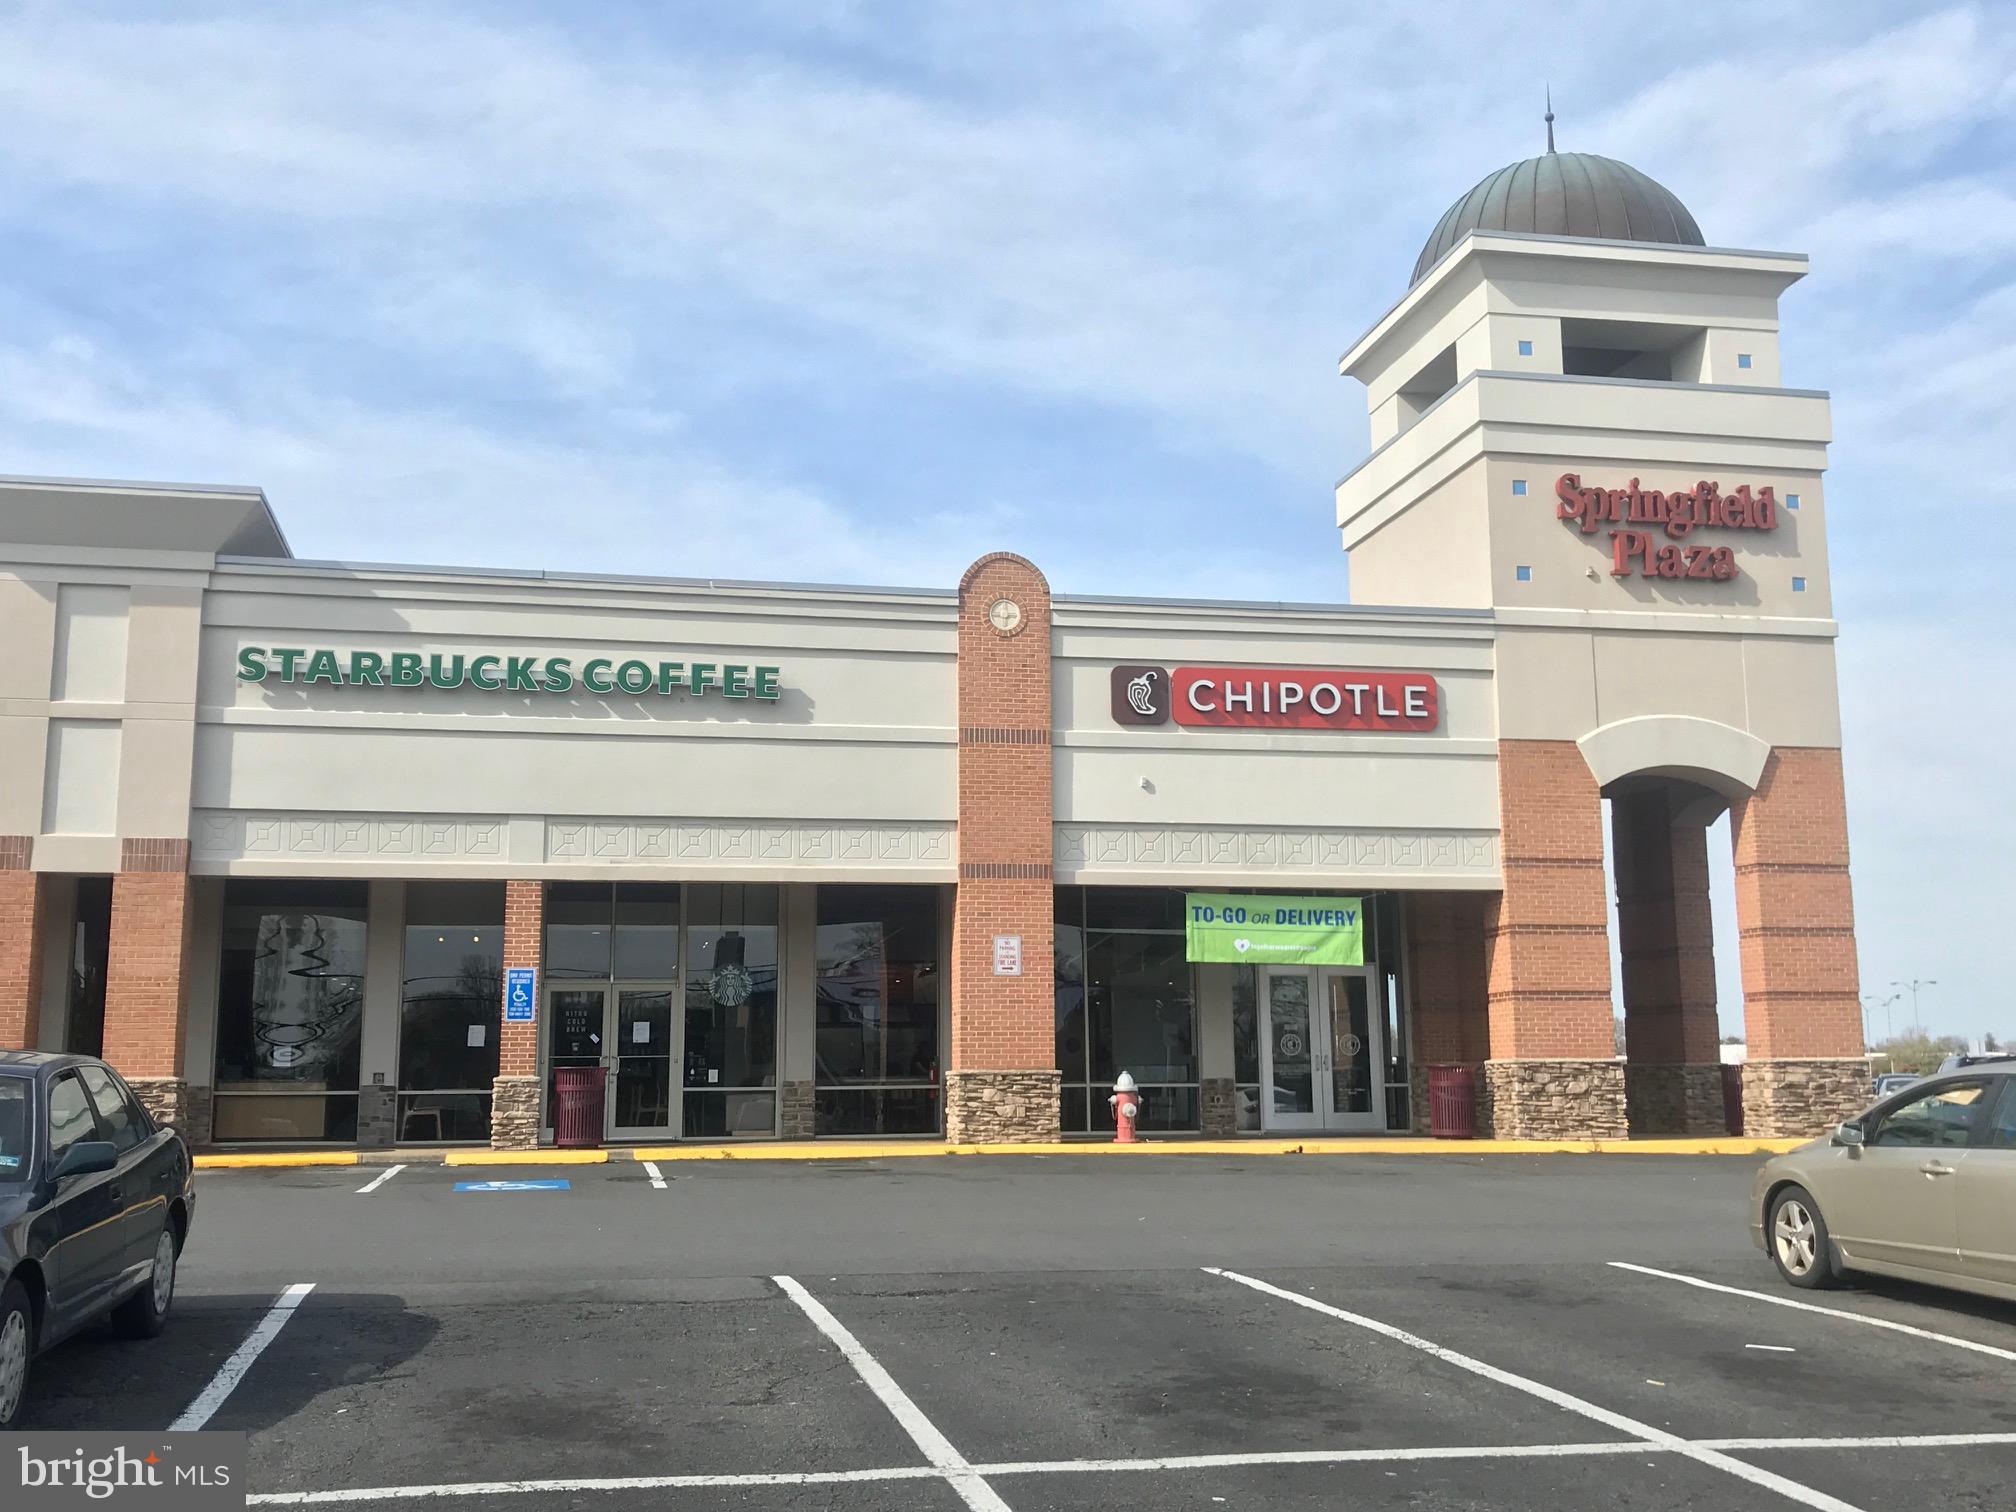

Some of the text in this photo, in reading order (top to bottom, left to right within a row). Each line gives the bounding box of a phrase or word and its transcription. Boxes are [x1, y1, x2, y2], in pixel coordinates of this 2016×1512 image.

[1555, 473, 1778, 539] Springfield
[1608, 530, 1739, 579] Plaza
[237, 646, 781, 699] STARBUCKS COFFEE
[1188, 679, 1429, 717] CHIPOTLE
[1192, 906, 1356, 926] TO-GO OR DELIVERY
